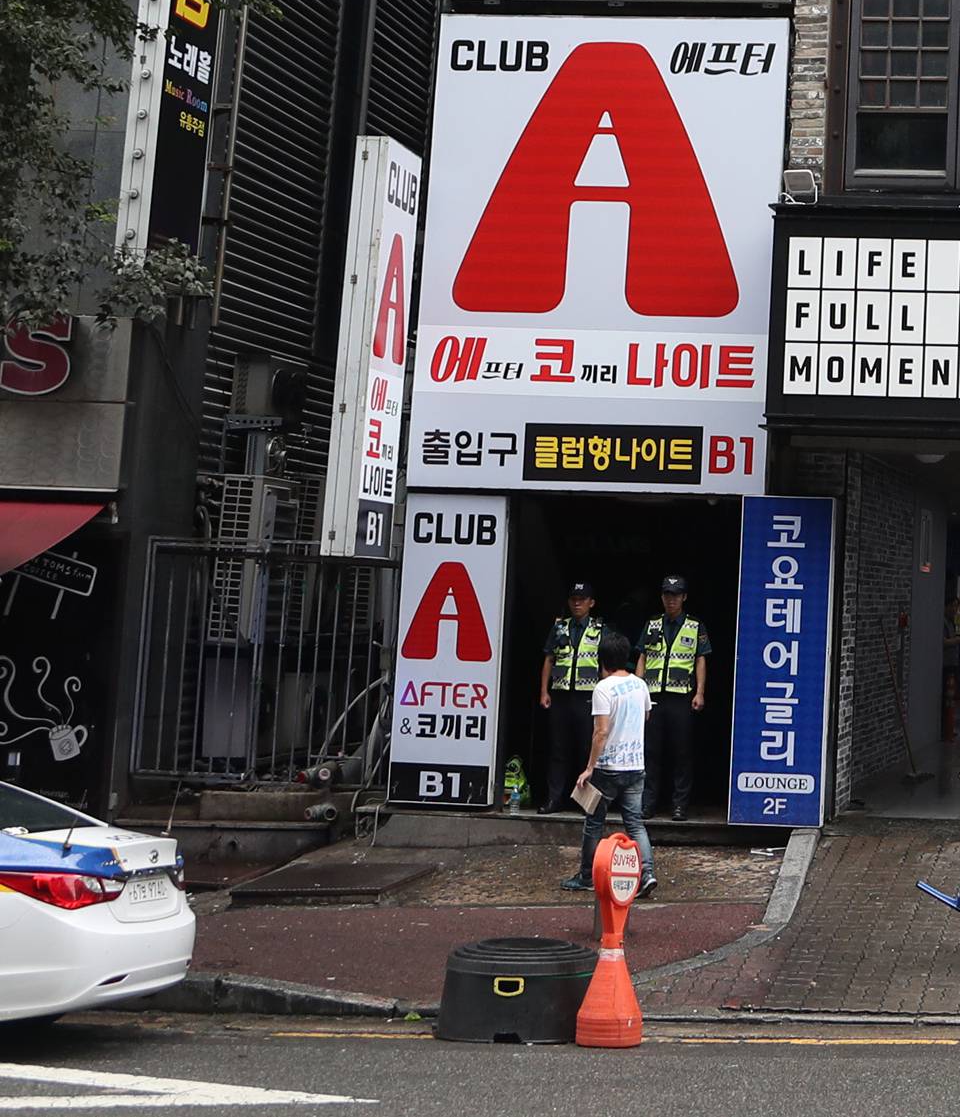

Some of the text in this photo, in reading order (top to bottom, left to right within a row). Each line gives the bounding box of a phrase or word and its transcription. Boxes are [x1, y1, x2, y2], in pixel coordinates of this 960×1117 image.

[167, 34, 213, 85] 노래홀
[450, 39, 550, 73] CLUB
[670, 41, 778, 76] 에프터
[164, 79, 208, 113] Music Room
[386, 160, 417, 216] CLUB
[451, 41, 740, 317] A
[798, 249, 916, 278] LIFE
[372, 233, 404, 365] A
[795, 302, 914, 331] FULL
[626, 342, 756, 389] 나이트
[421, 428, 755, 476] 출입구 클럽형나이트 B1
[362, 463, 394, 499] 나이트
[365, 510, 384, 547] B1
[412, 512, 498, 546] CLUB
[401, 561, 493, 662] A
[400, 680, 488, 709] AFTER
[415, 713, 487, 741] 코끼리
[418, 770, 461, 799] B1
[744, 776, 809, 791] LOUNGE
[763, 797, 788, 815] 2F
